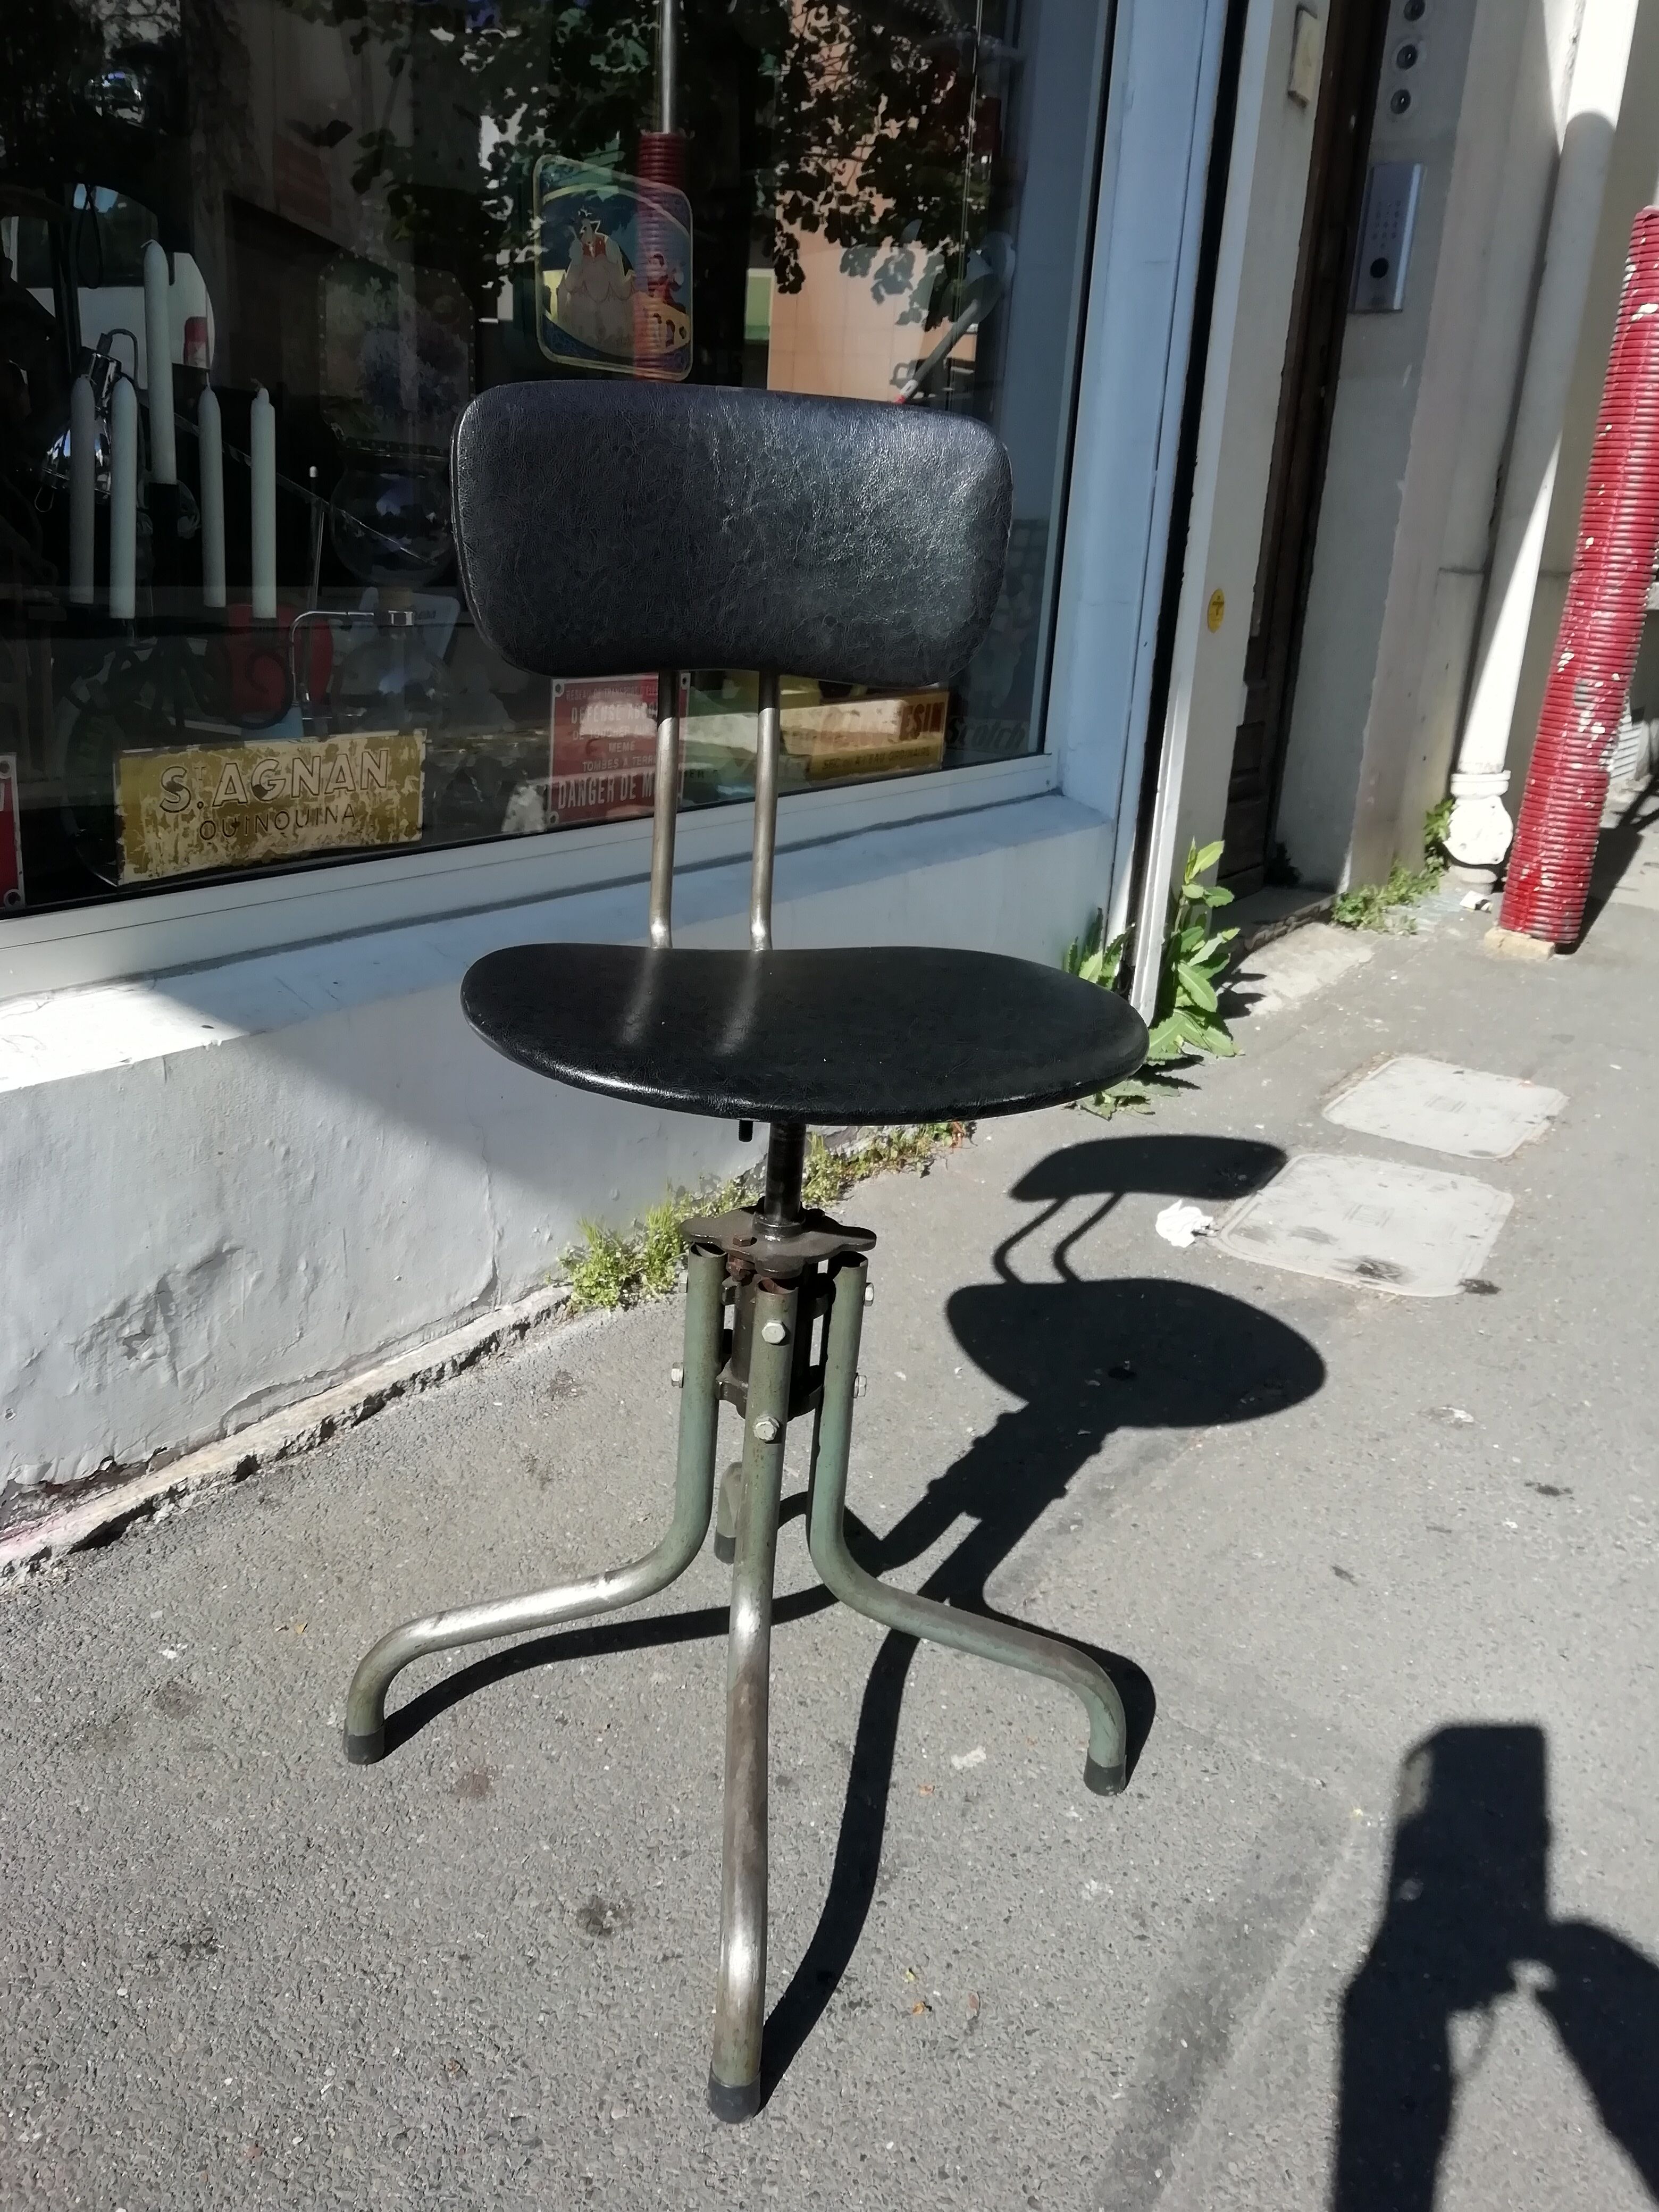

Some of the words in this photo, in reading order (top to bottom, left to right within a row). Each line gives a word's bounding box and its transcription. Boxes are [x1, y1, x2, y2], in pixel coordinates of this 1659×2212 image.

[571, 703, 622, 724] DEFENSE
[213, 749, 389, 807] AGNAN
[582, 757, 619, 772] TOMBES
[622, 757, 629, 767] A
[632, 754, 656, 767] TERR
[558, 776, 615, 809] DANGER
[619, 773, 637, 801] DE
[200, 803, 356, 844] QUINQUINA
